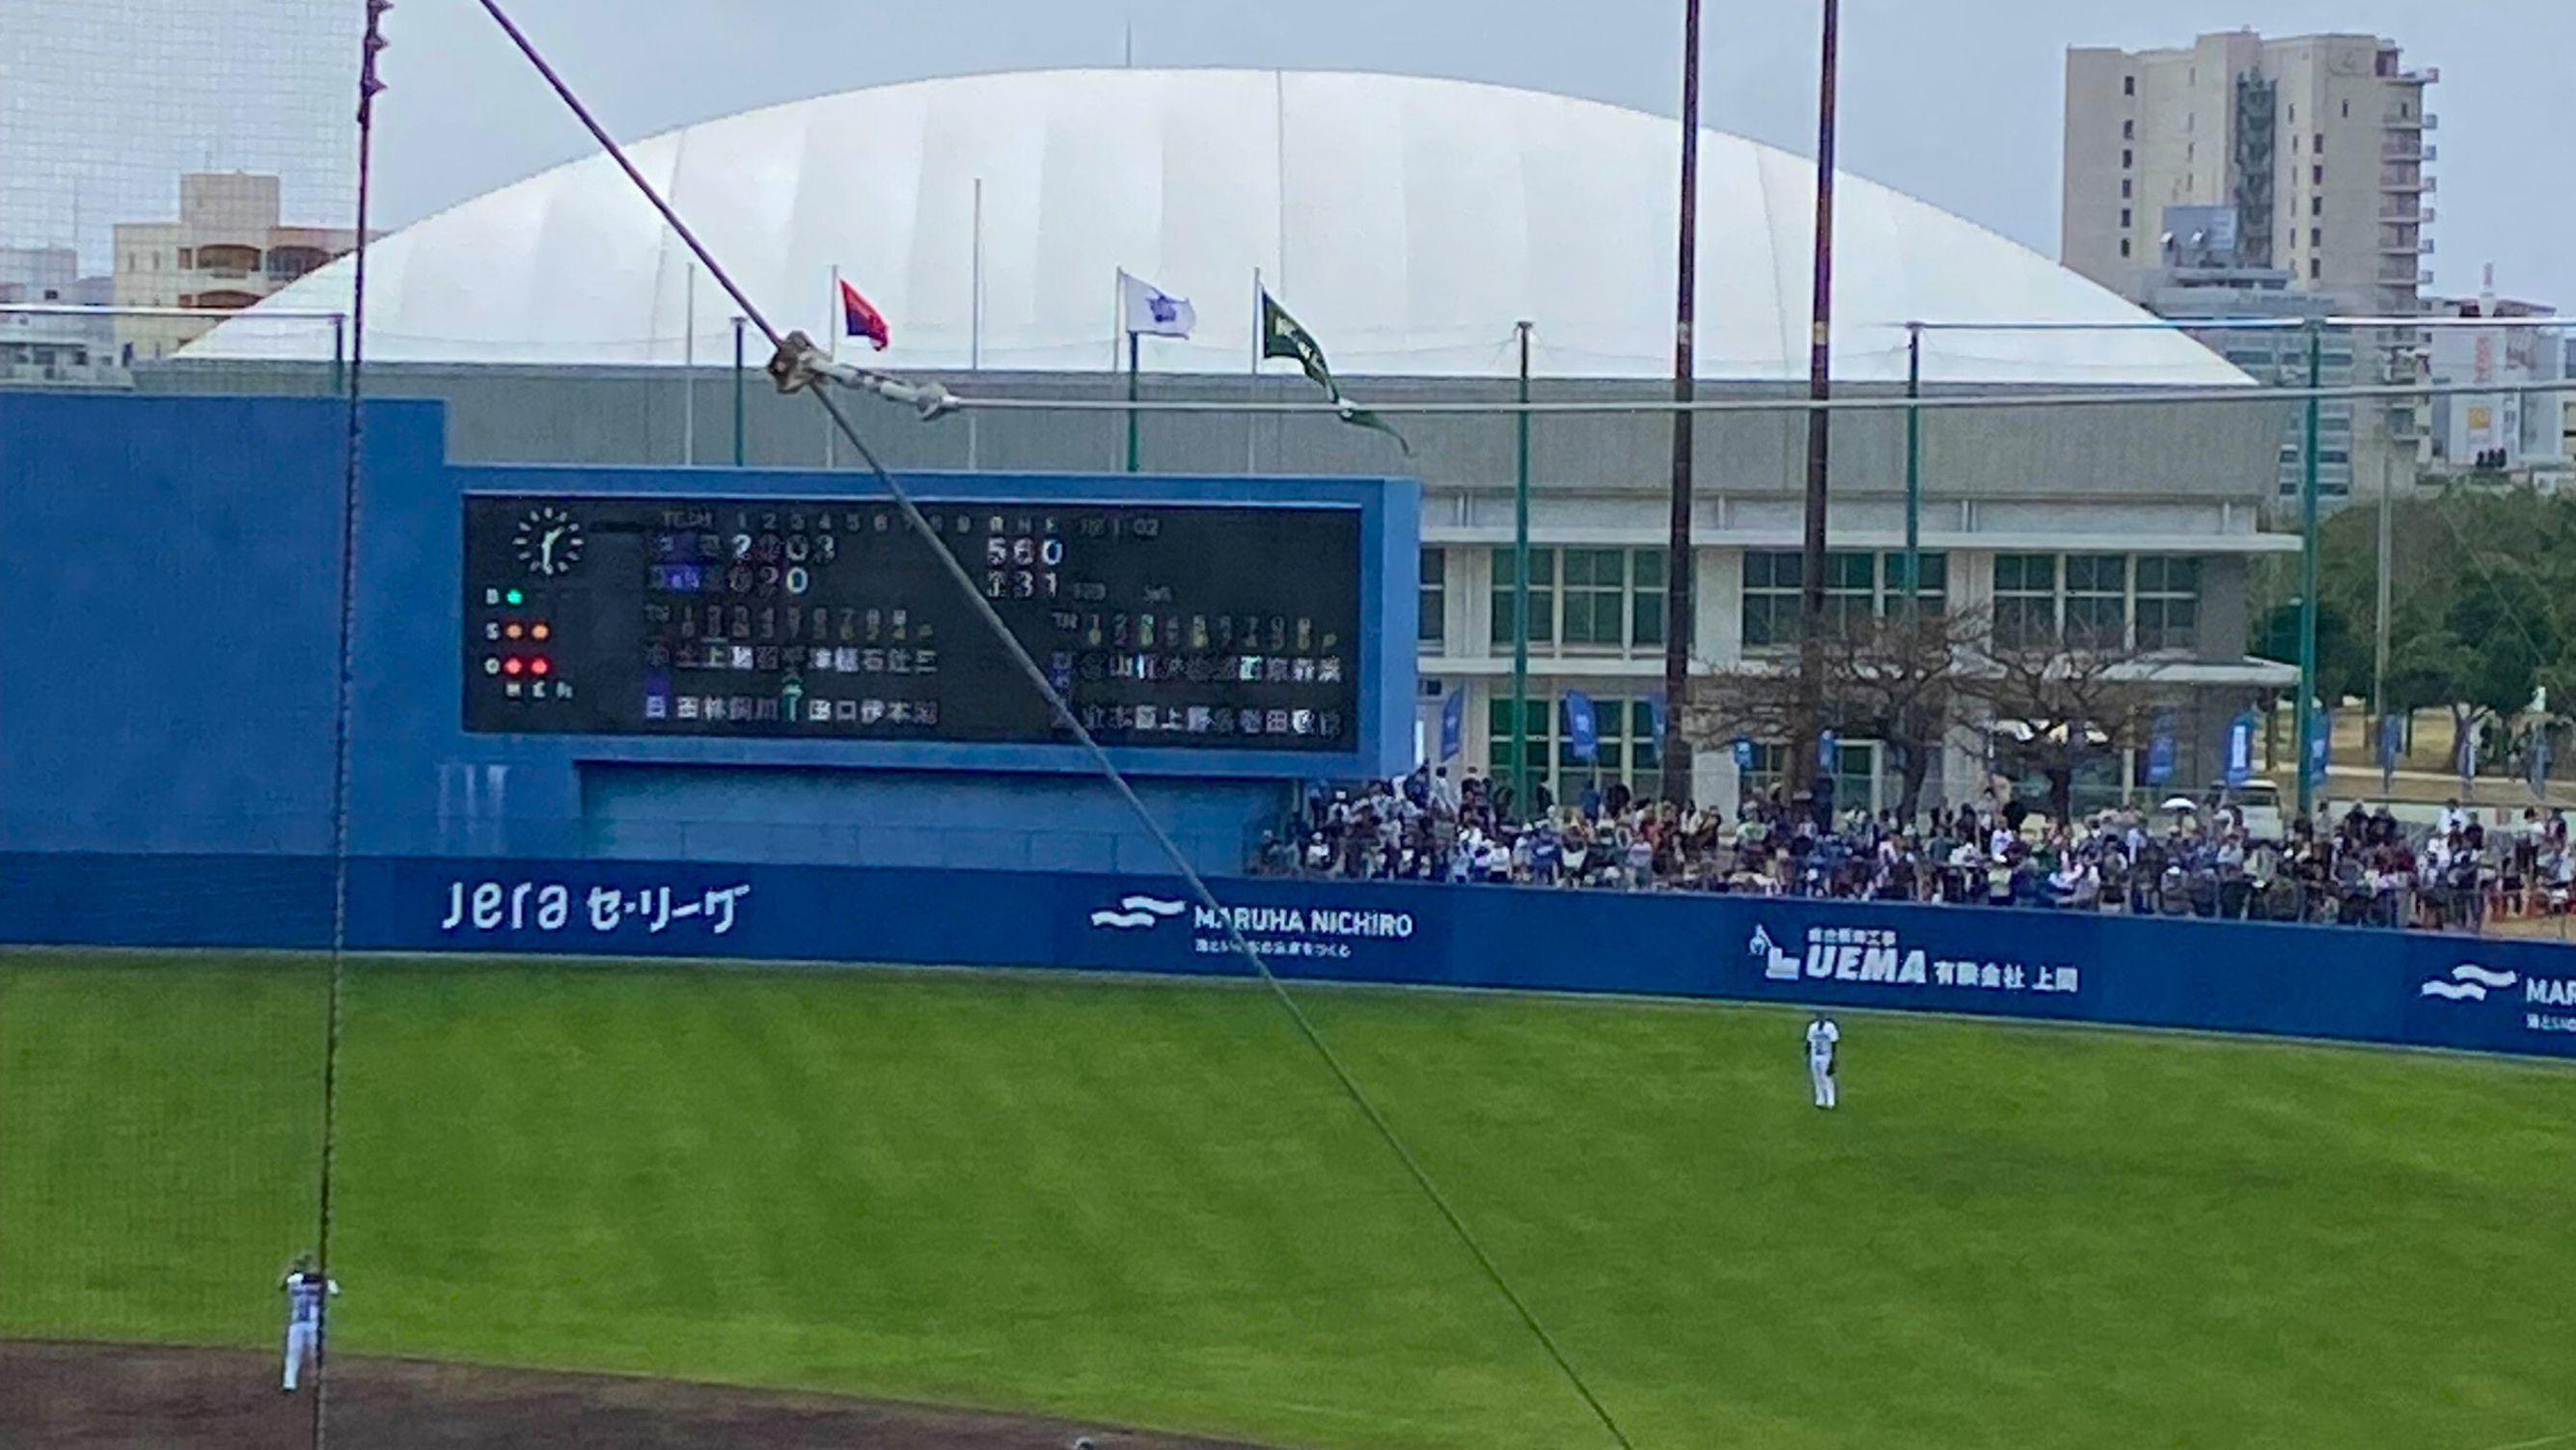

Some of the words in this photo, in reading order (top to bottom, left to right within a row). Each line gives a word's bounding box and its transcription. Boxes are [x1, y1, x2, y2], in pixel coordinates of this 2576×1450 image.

[786, 567, 808, 593] 0
[1310, 908, 1412, 937] NICHIRO
[1806, 944, 1927, 983] UEMA
